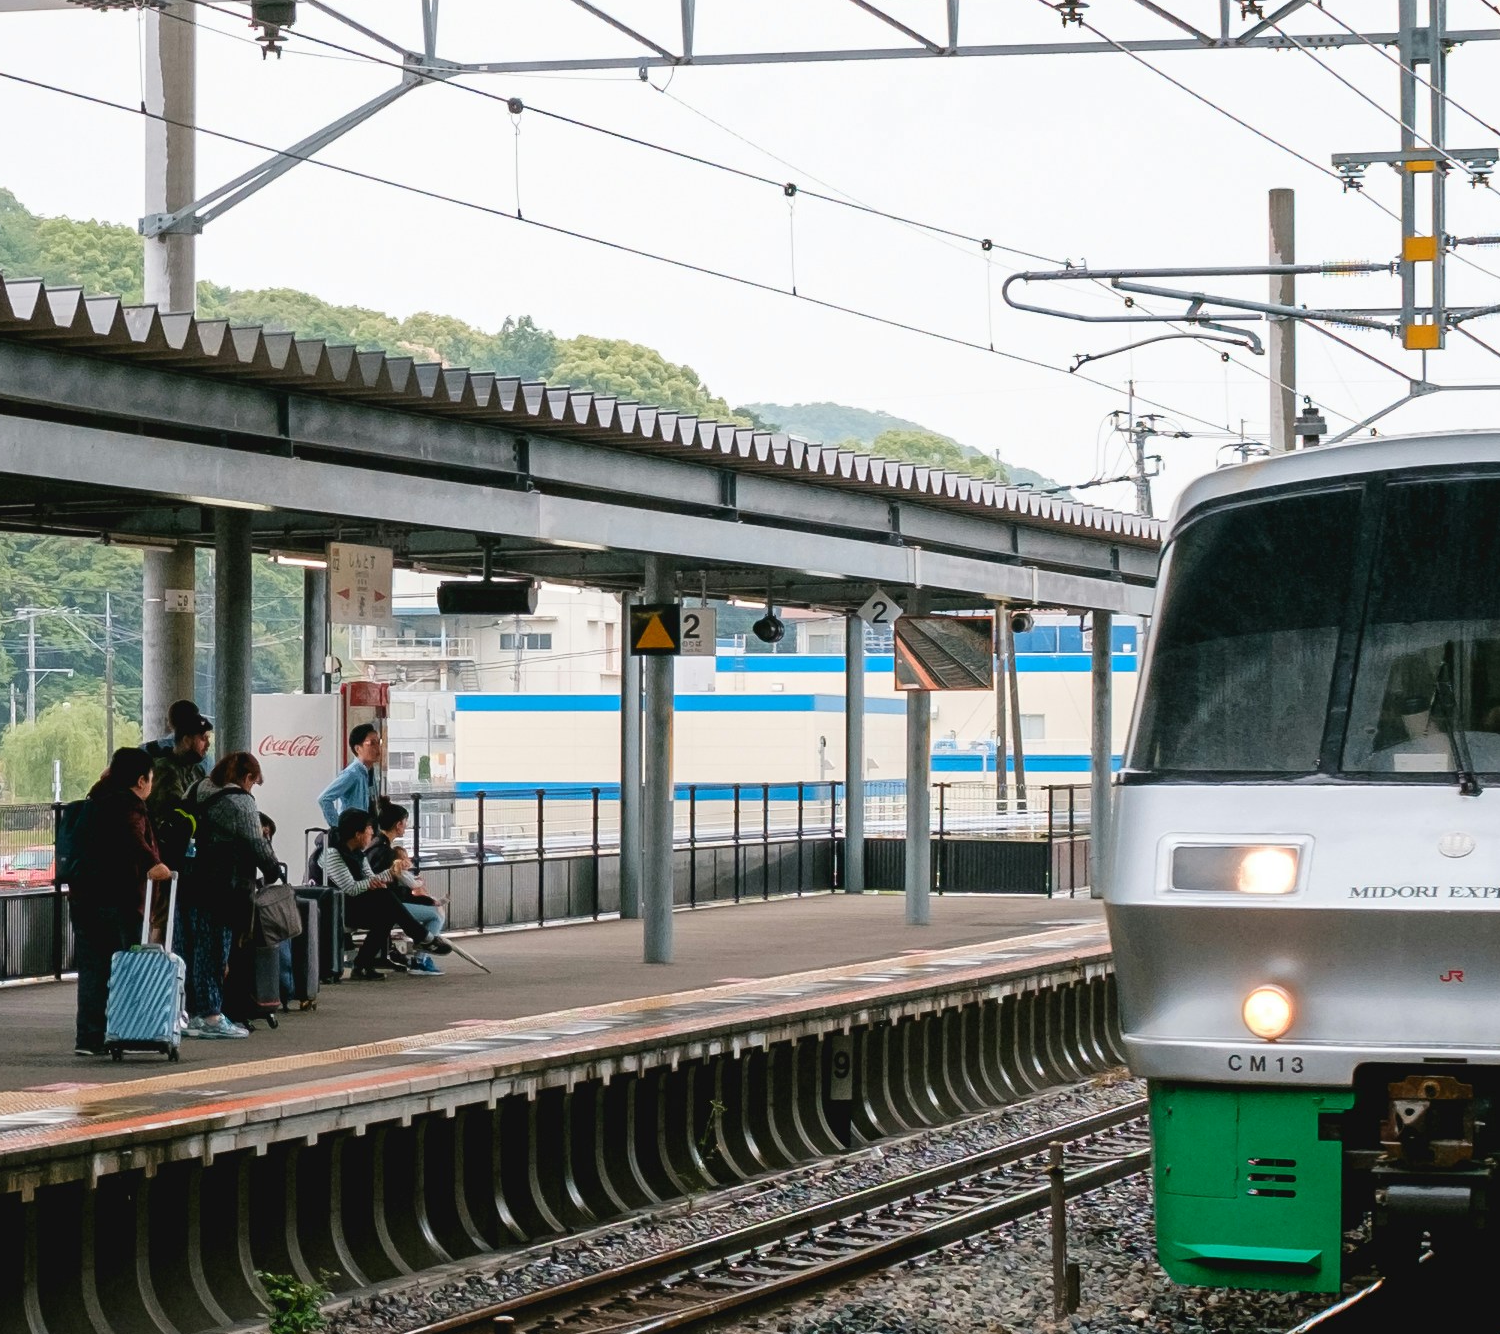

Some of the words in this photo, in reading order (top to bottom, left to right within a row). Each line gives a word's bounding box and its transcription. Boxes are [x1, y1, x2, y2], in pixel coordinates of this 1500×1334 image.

[872, 601, 888, 624] 2
[683, 613, 700, 639] 2
[1347, 885, 1439, 899] MIDORI
[1439, 969, 1465, 983] JR
